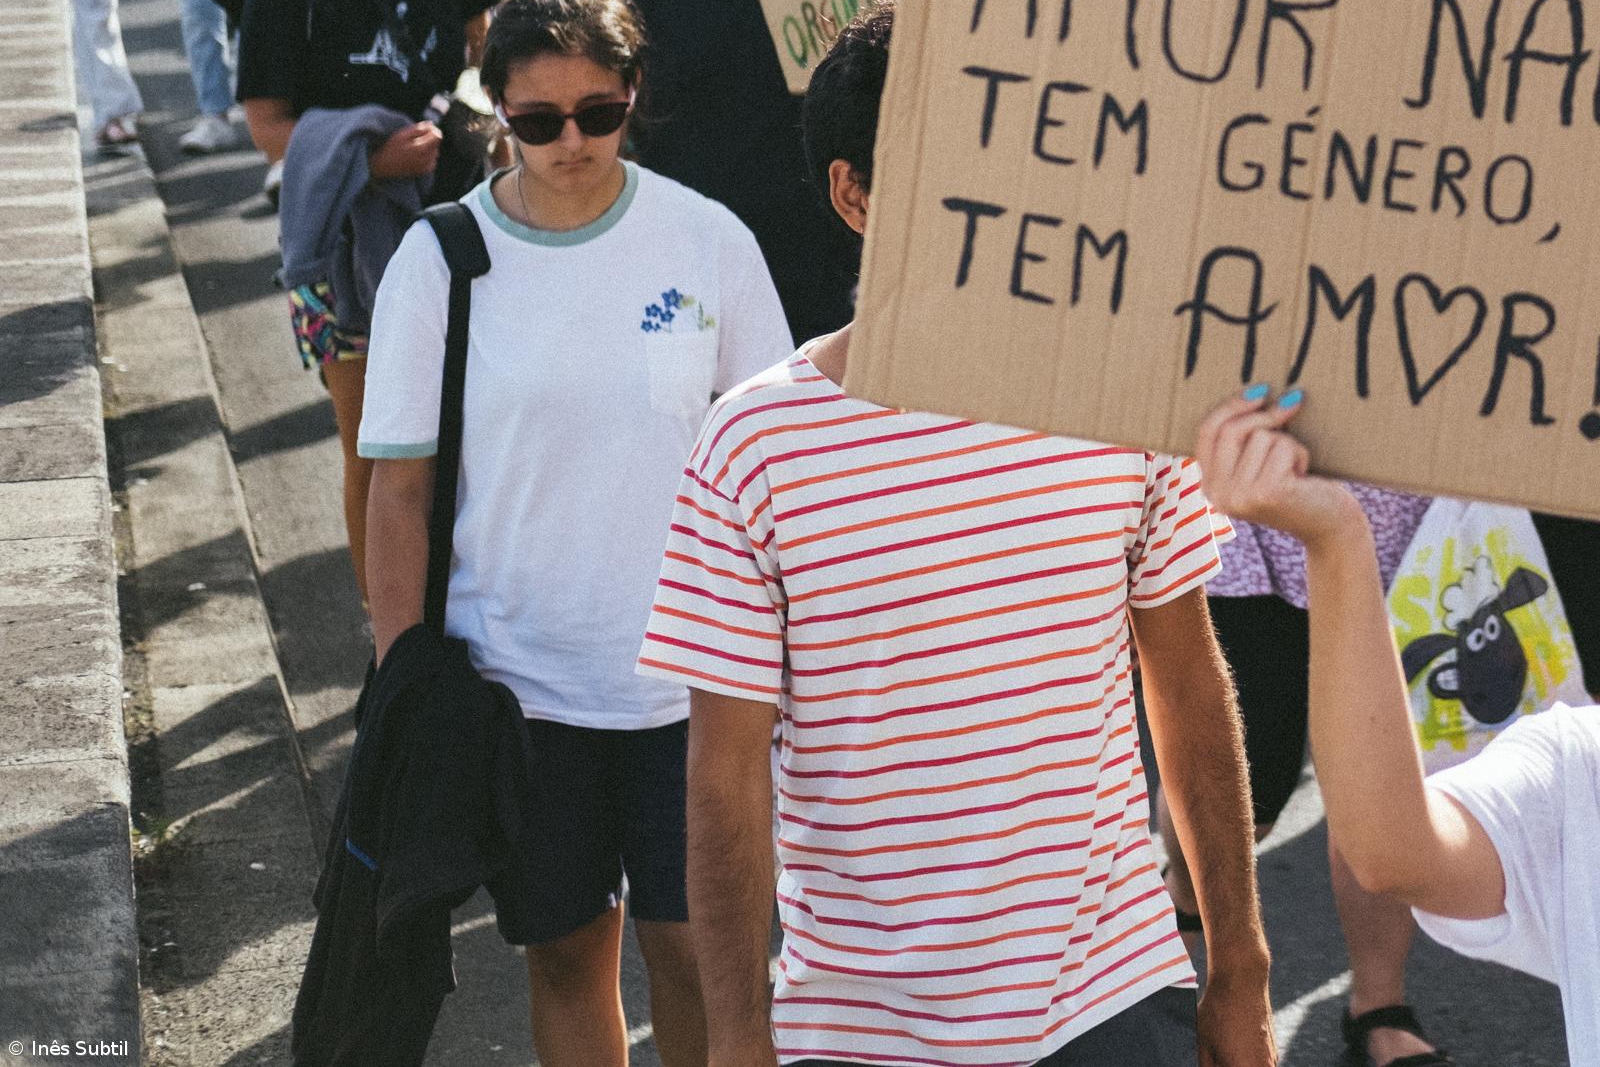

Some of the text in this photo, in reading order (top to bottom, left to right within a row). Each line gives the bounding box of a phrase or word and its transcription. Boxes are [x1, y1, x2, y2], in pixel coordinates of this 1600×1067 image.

[962, 65, 1563, 245] TEM GÉNERO,
[942, 197, 1130, 315] TEM
